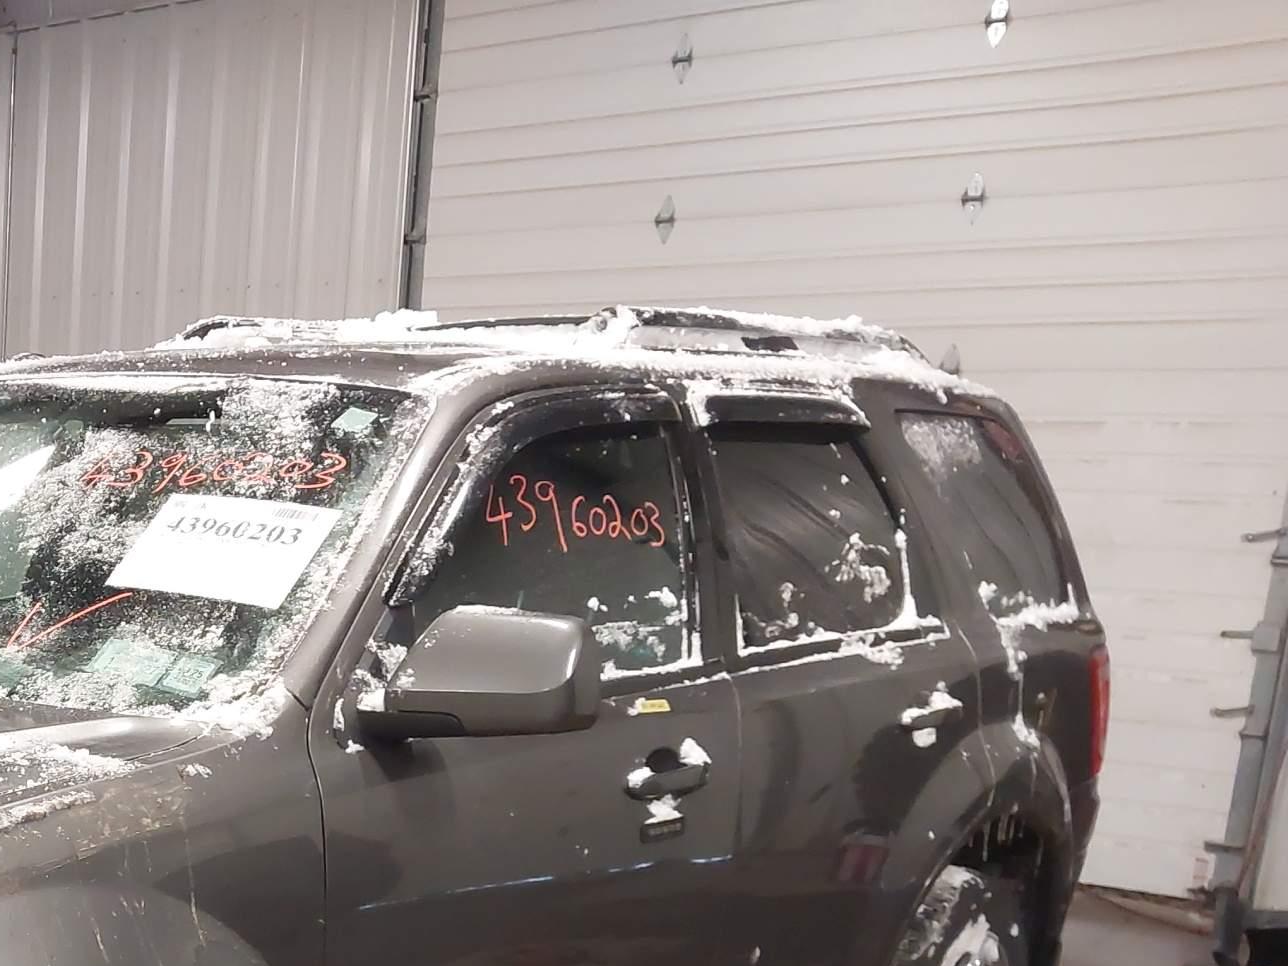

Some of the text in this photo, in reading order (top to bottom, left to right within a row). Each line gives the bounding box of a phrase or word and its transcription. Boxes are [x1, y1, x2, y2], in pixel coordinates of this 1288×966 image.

[80, 449, 347, 494] 43960203
[167, 515, 303, 545] 43960203
[485, 475, 665, 553] 43960203
